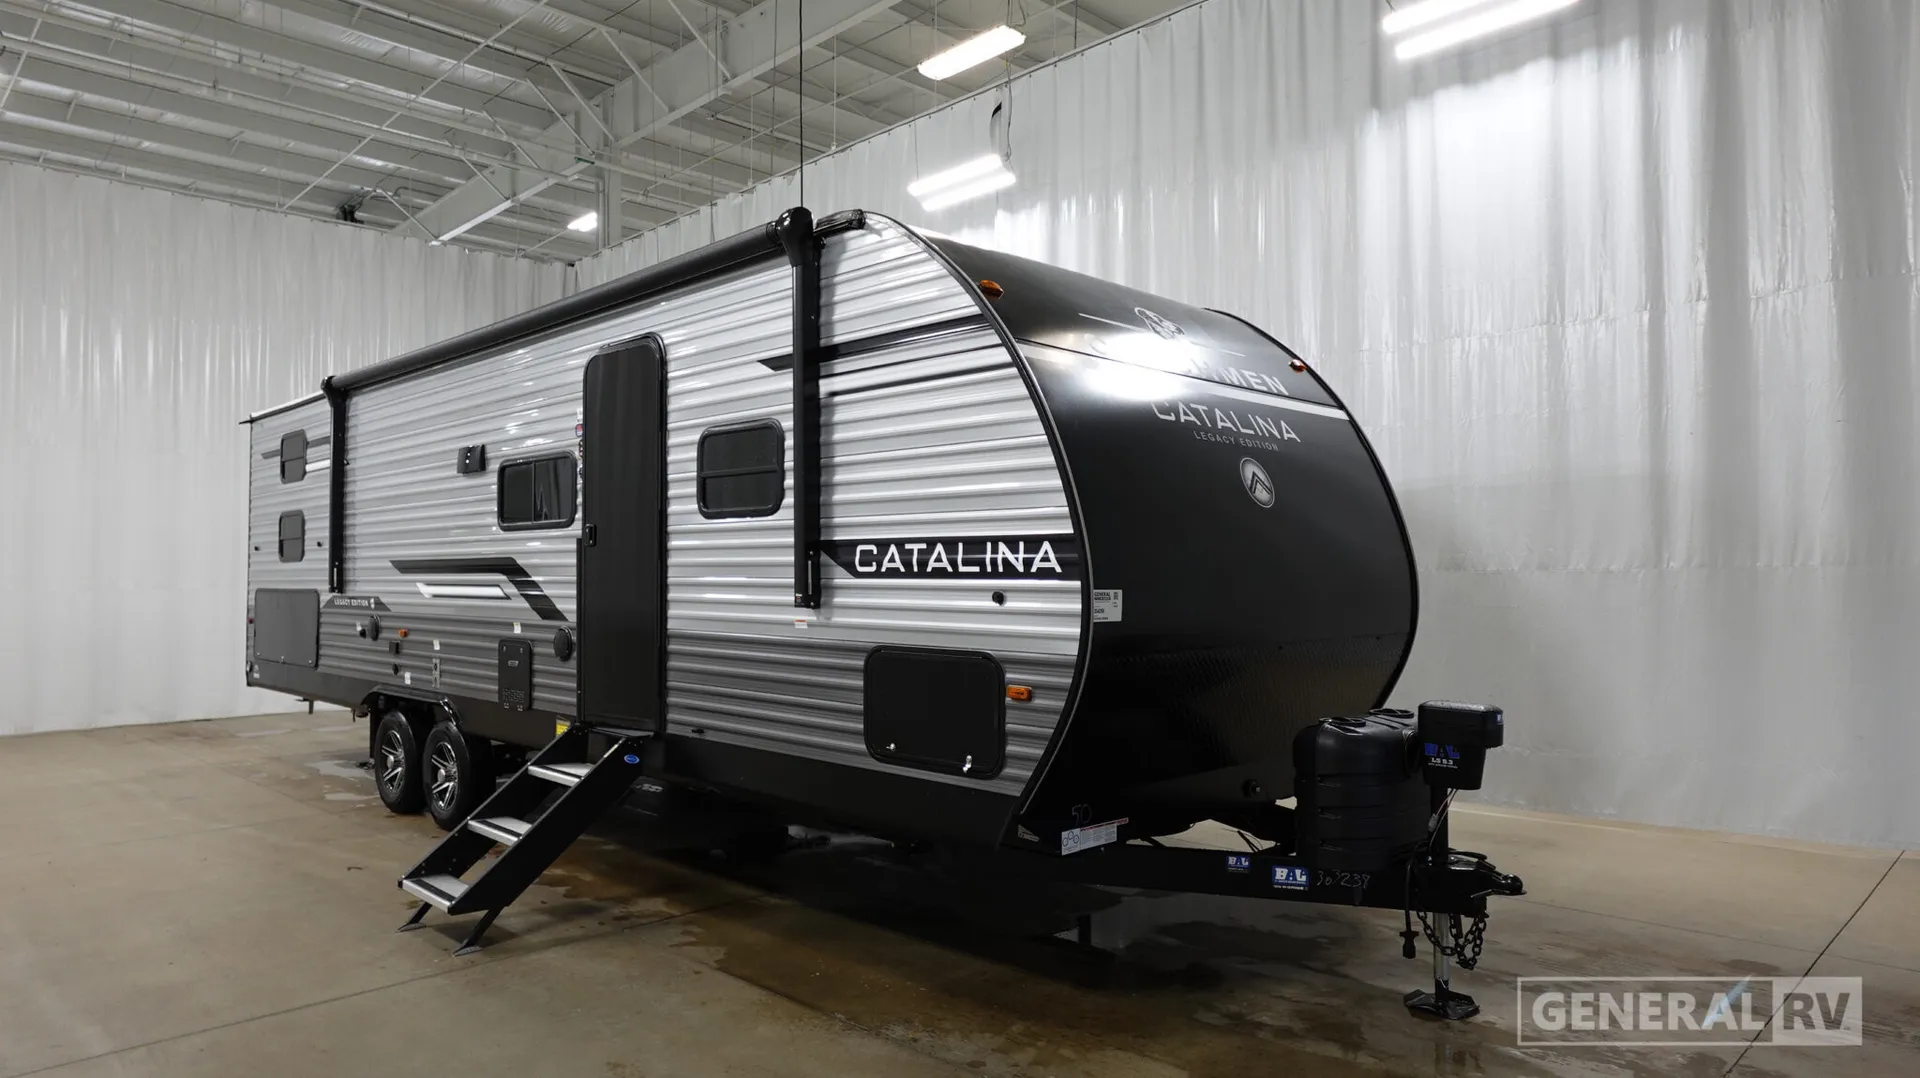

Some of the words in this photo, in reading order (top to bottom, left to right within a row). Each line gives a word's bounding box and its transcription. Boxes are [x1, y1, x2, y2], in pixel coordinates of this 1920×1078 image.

[1151, 400, 1301, 442] CATALINA
[1193, 430, 1235, 445] LEGACY
[1239, 438, 1280, 452] EDITION
[854, 540, 1063, 573] CATALINA
[1274, 867, 1307, 881] BAL
